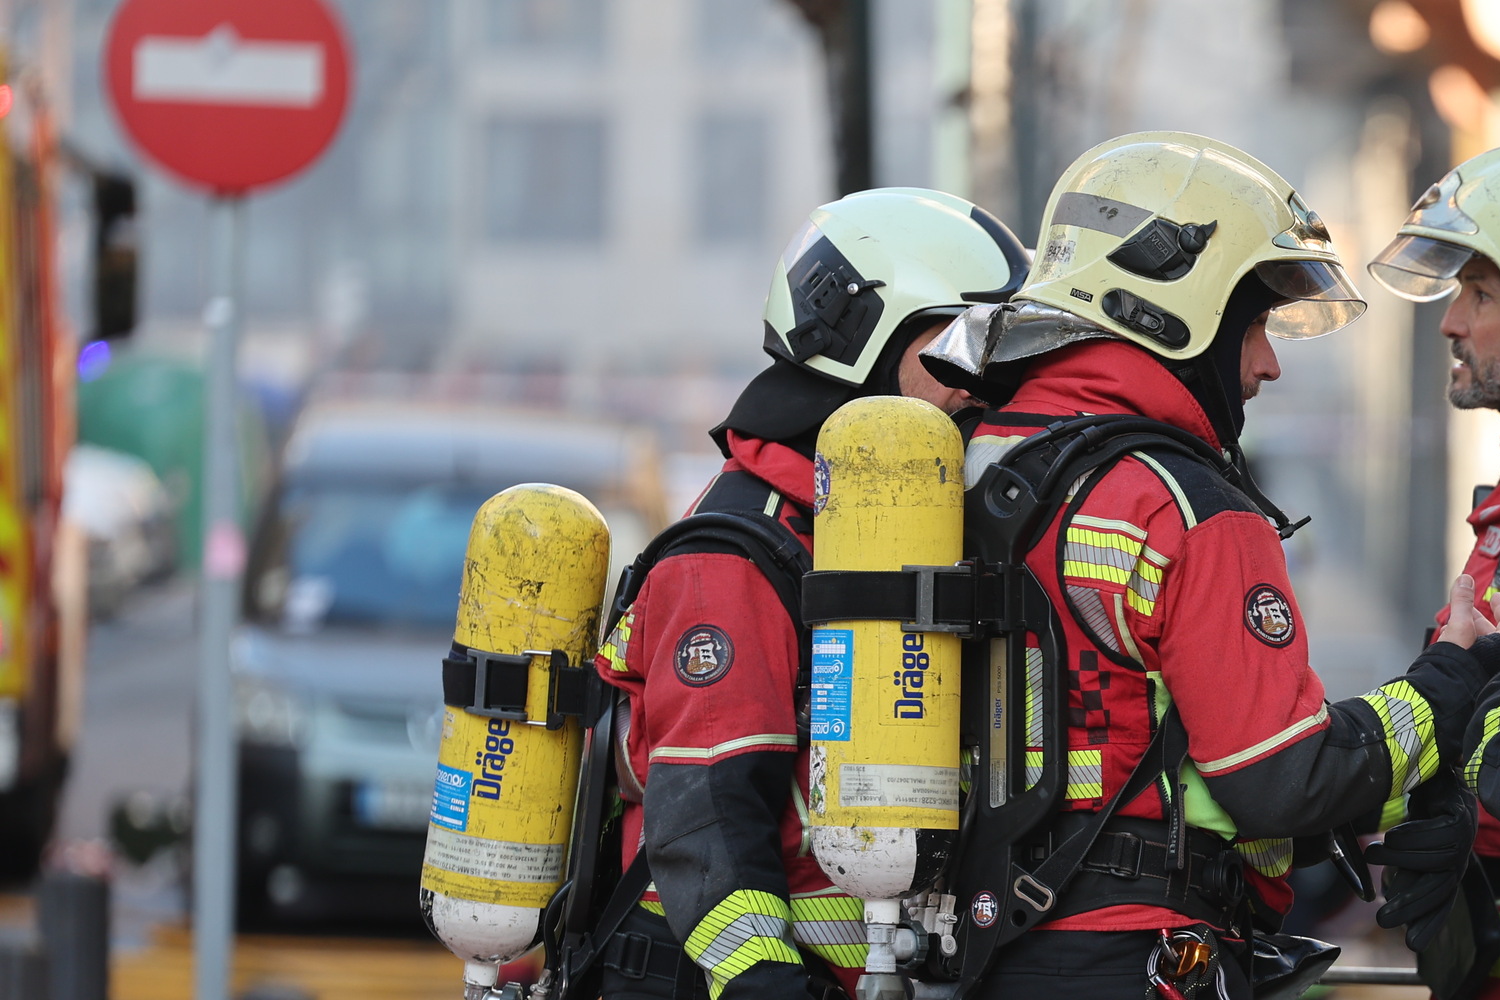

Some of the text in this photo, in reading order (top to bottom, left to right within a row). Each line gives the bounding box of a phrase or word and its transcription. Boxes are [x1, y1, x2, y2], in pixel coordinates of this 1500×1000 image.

[1071, 289, 1092, 302] MSA
[893, 633, 930, 719] Dräge
[993, 697, 1003, 729] Dräger
[471, 717, 515, 801] Dräge
